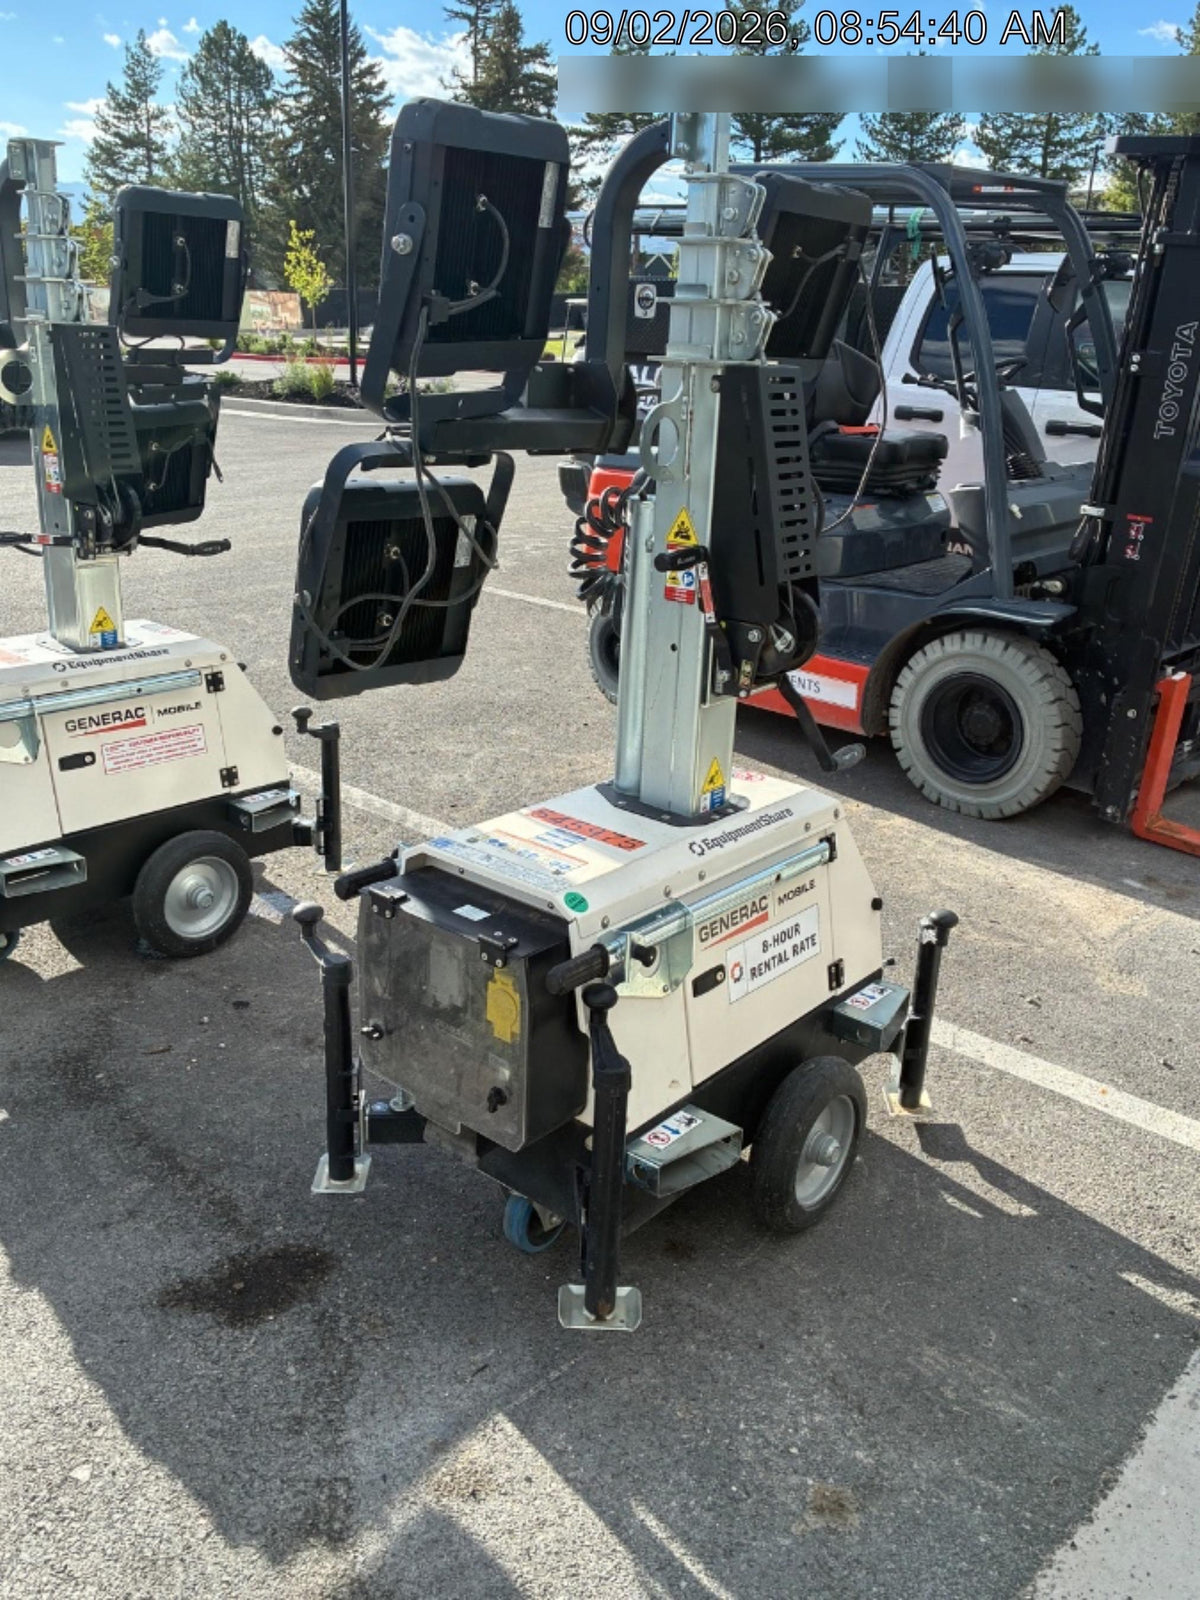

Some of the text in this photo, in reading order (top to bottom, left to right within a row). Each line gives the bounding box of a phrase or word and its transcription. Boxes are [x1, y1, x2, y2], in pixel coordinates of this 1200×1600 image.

[1154, 321, 1199, 440] TOYOTA
[68, 648, 170, 669] EquipmentShare
[65, 701, 202, 733] GENERAC MOBILE
[704, 806, 794, 851] EquipmentShare
[699, 879, 816, 943] GENERAC MOBILE
[750, 933, 818, 981] RENTAL RATE
[762, 922, 801, 954] 8-HOUR
